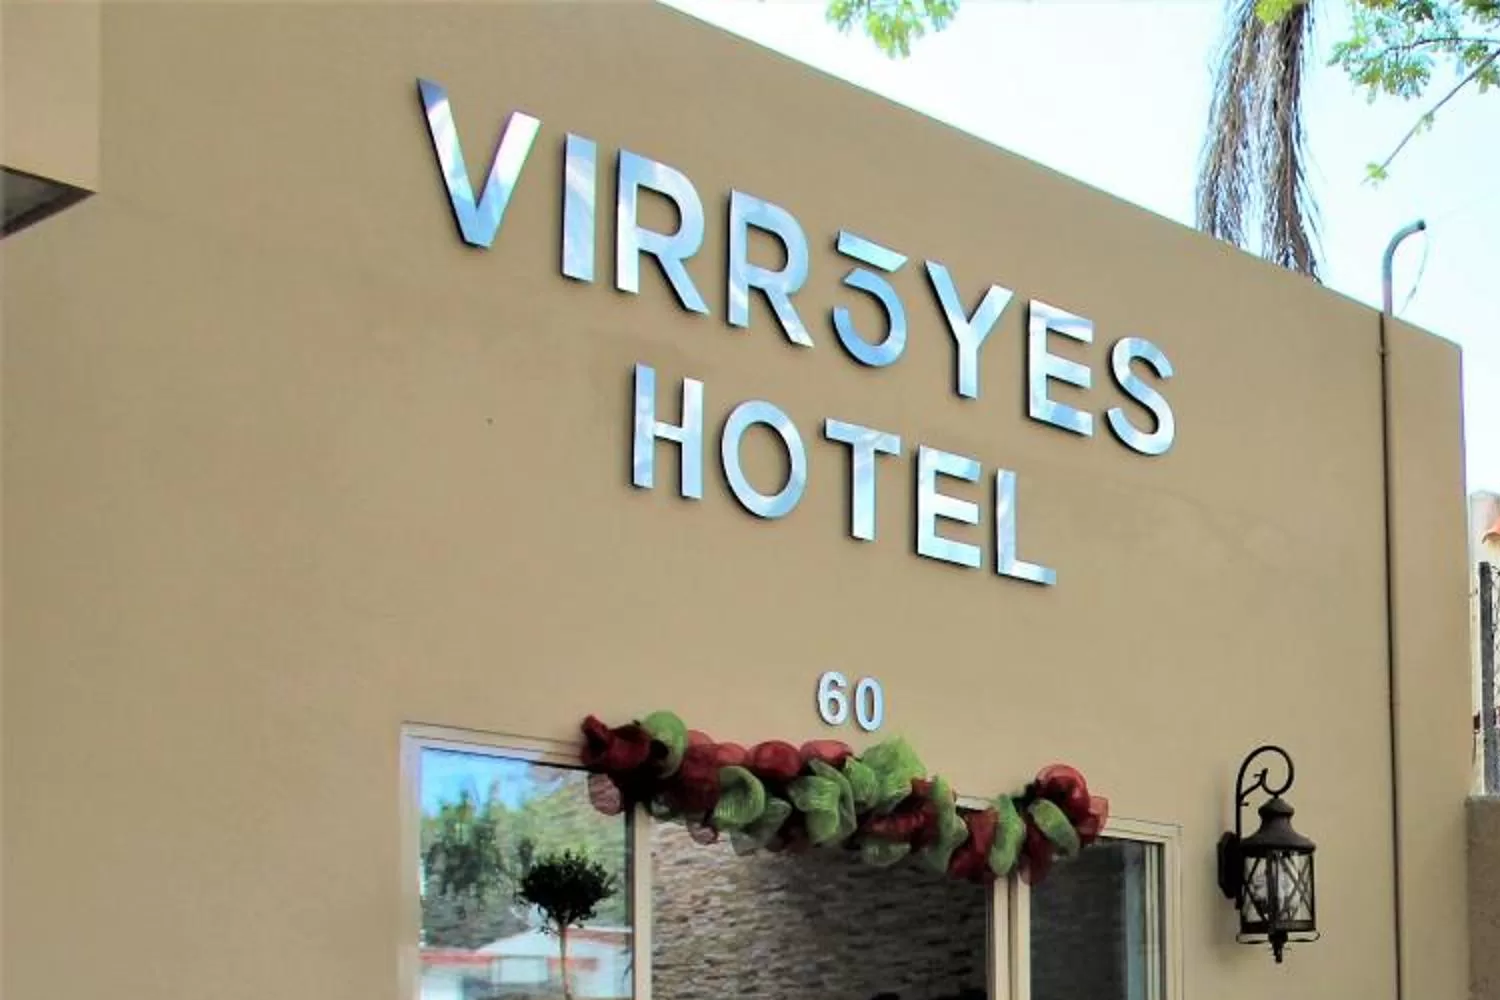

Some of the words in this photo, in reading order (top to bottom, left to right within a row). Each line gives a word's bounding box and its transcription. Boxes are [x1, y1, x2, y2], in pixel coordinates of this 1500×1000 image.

[417, 77, 1176, 456] VIRR3YES
[632, 362, 1057, 586] HOTEL
[816, 671, 884, 733] 60
